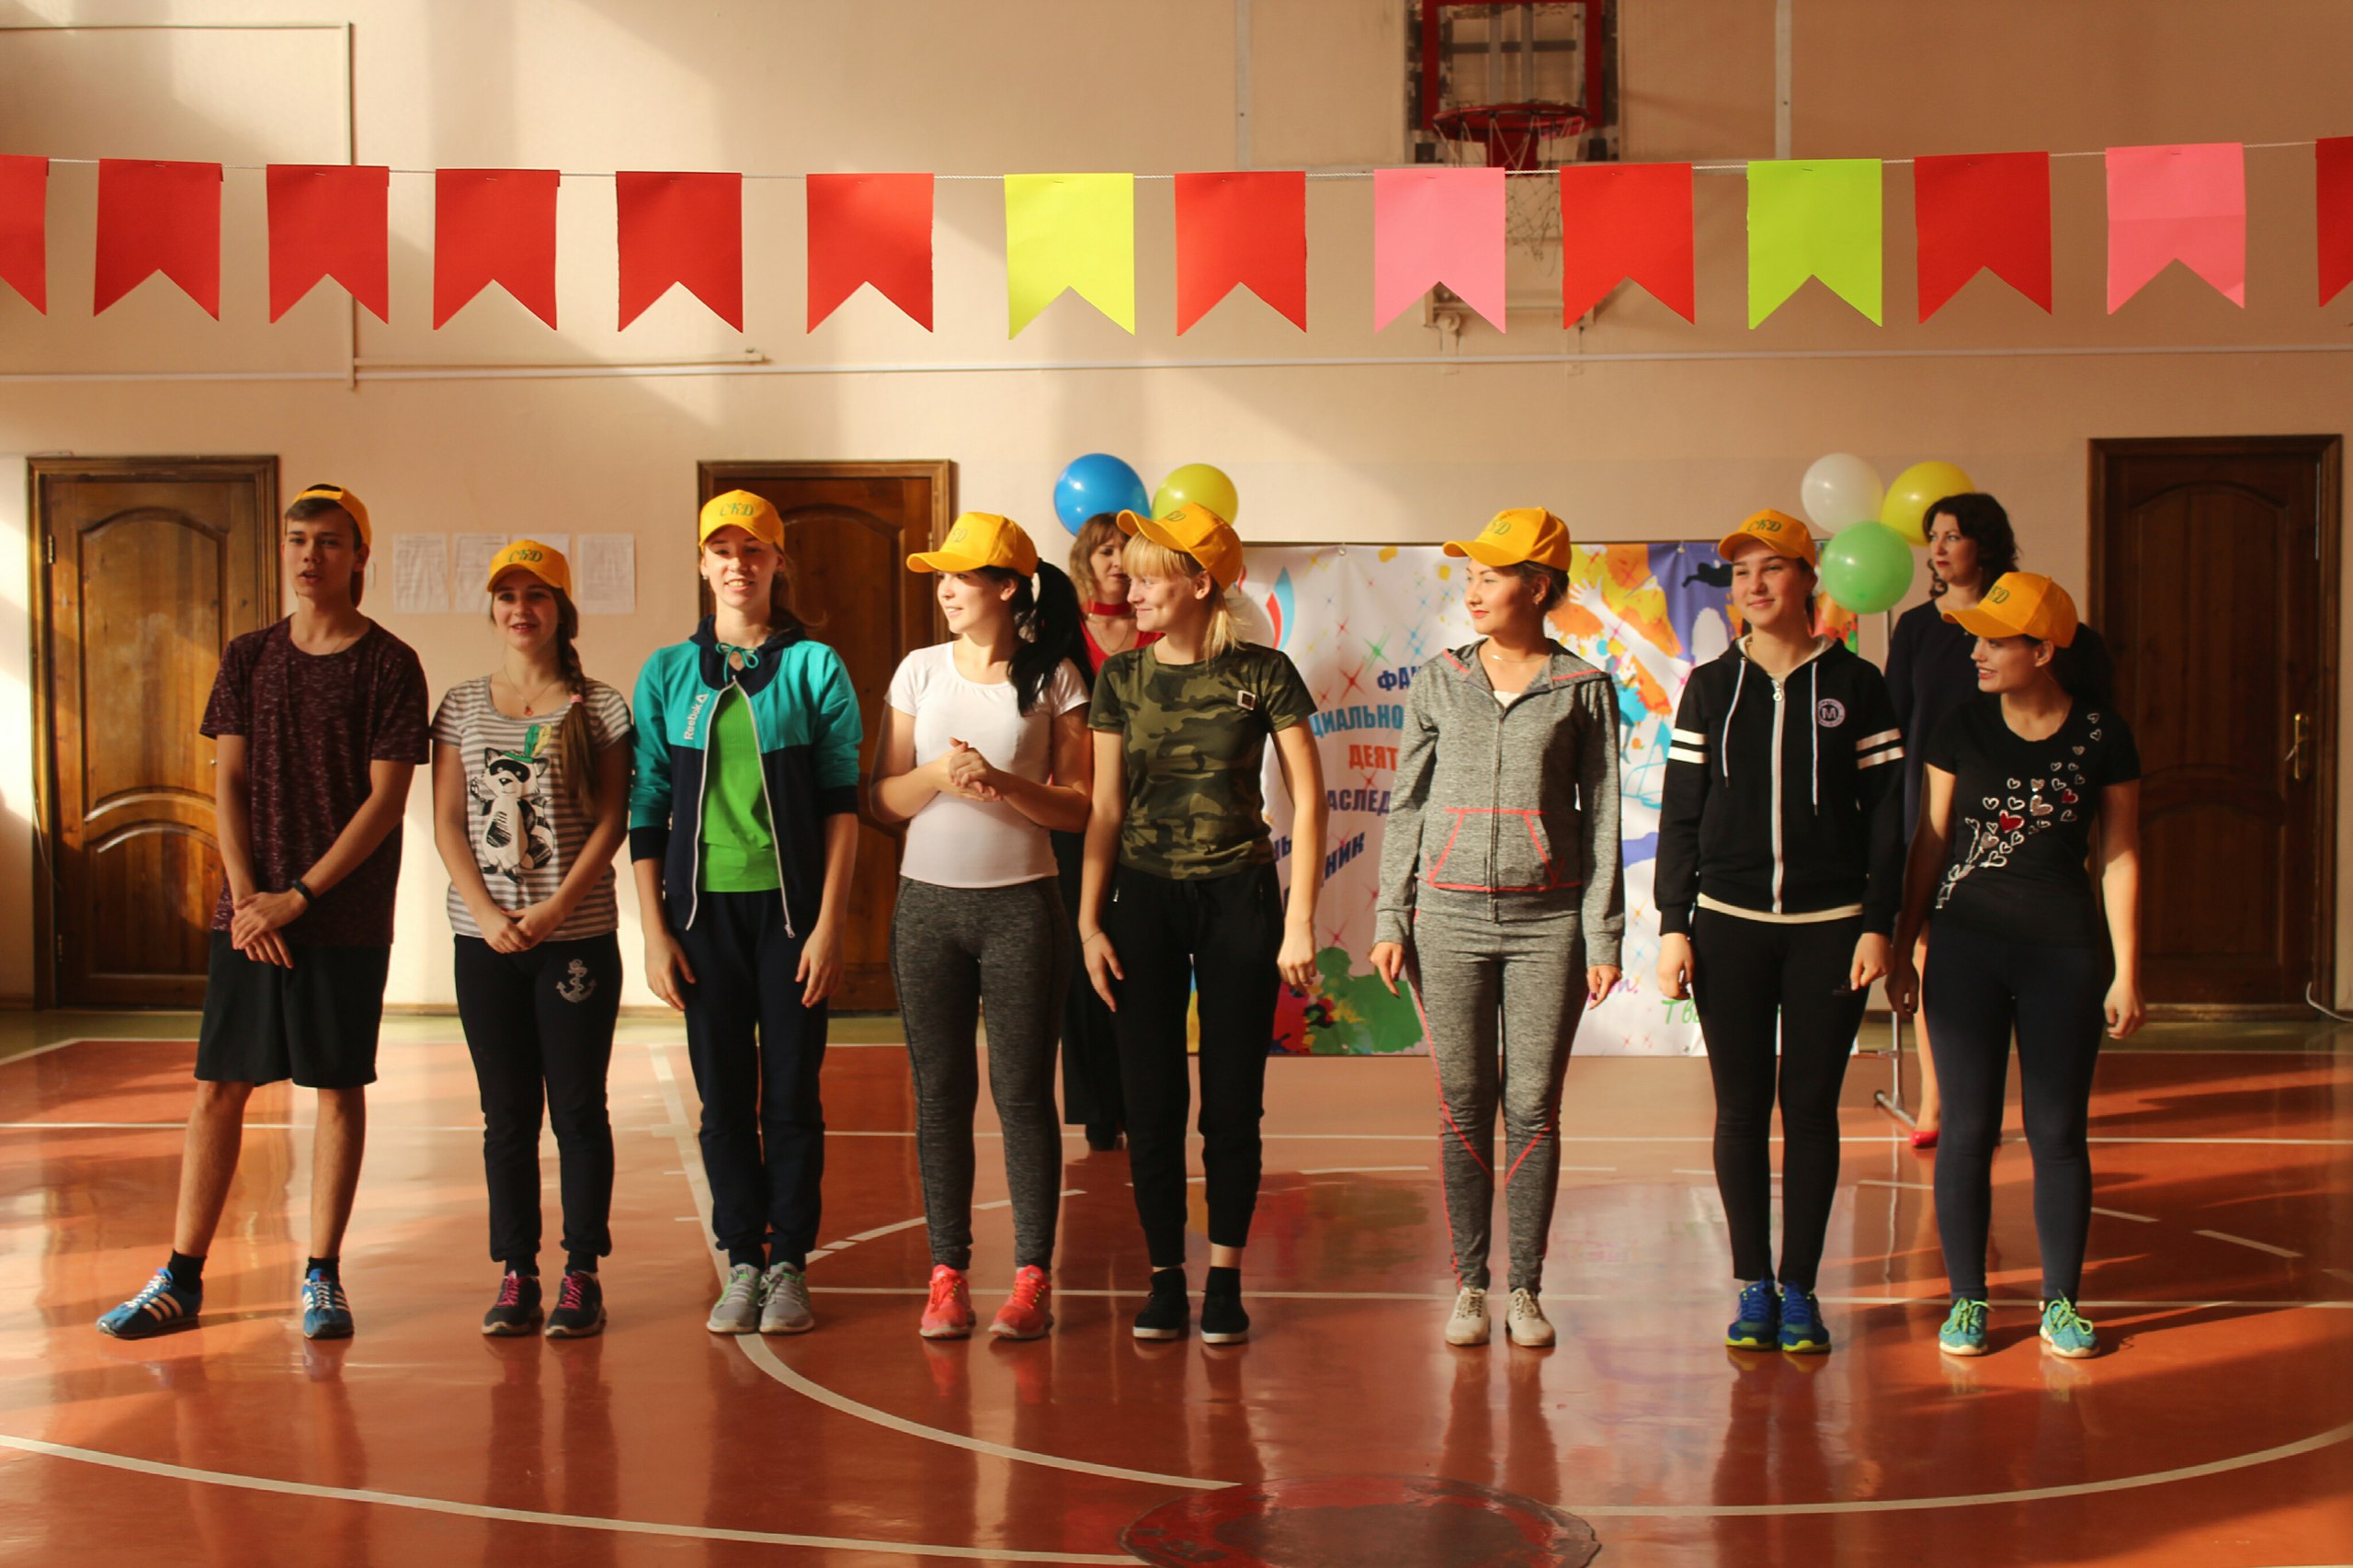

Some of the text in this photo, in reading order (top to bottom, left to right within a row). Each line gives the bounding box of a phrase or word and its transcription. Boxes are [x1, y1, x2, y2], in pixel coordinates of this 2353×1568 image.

[684, 703, 703, 740] Reebok
[1348, 744, 1398, 771] ДЕЯТ
[1326, 789, 1392, 816] АСЛЕД
[1322, 831, 1366, 884] НИК
